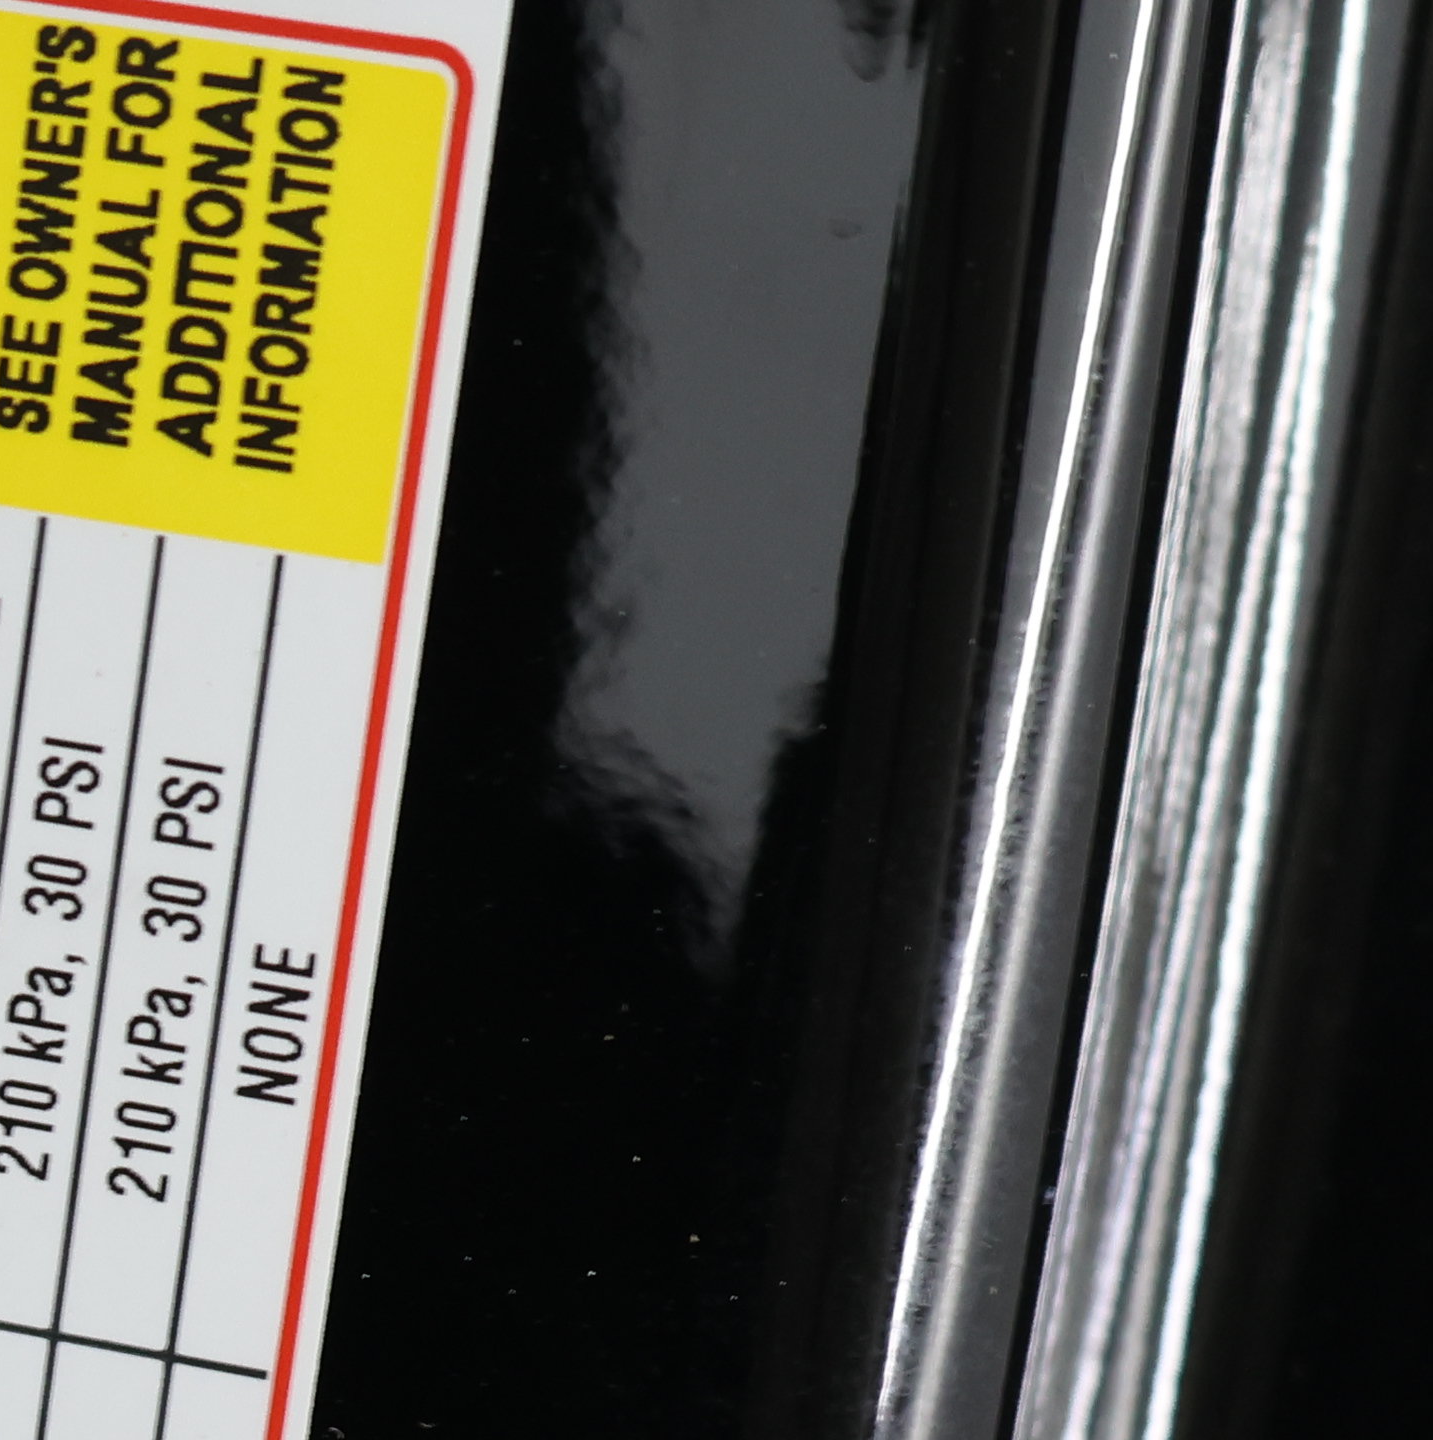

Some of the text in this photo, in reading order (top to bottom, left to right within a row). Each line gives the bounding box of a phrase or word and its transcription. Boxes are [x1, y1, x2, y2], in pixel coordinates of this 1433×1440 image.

[6, 24, 99, 303] OWNER'S
[69, 36, 181, 449] MANUAL FOR
[154, 56, 265, 459] ADDITIONAL
[232, 64, 347, 475] INFORMATION
[21, 853, 89, 923] 30
[31, 736, 105, 831] PSI
[1, 953, 86, 1065] kPa,
[105, 756, 225, 1204] 210 kPa, 30 PSI
[233, 943, 317, 1107] NONE
